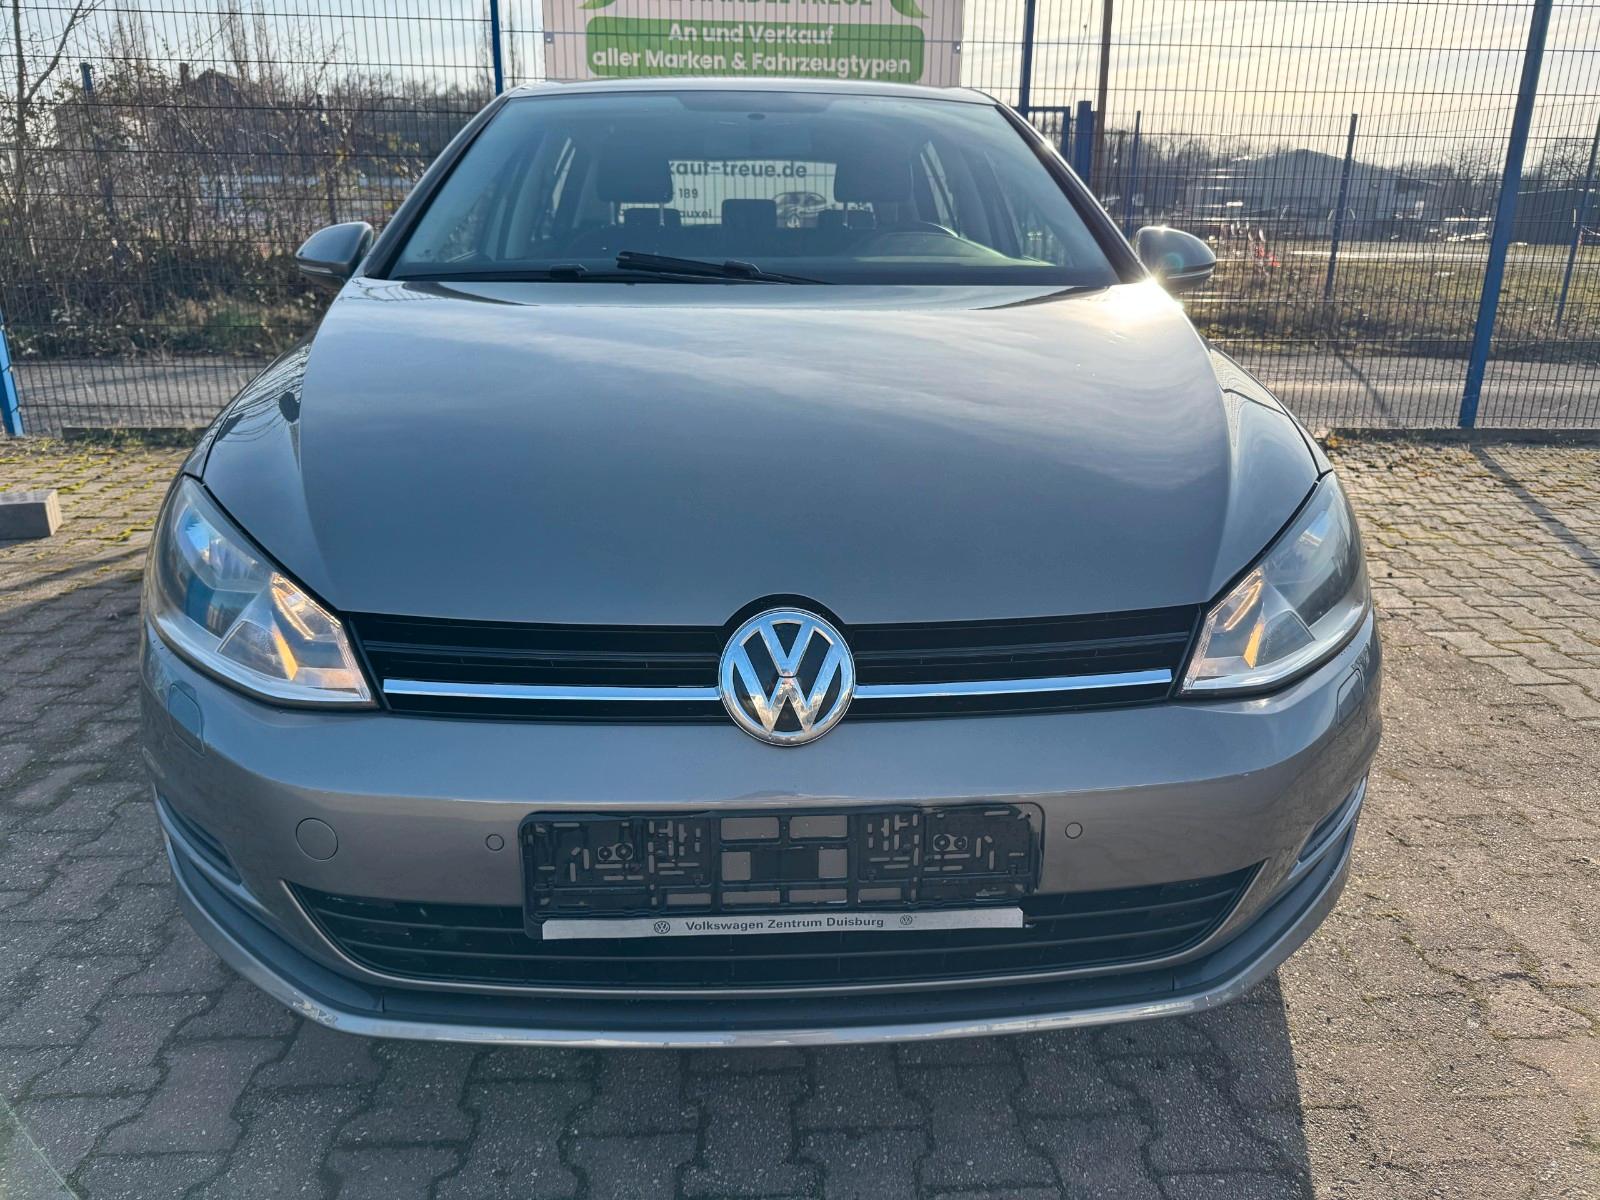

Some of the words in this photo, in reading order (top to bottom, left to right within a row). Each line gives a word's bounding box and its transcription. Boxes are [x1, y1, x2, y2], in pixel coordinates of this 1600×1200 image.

[668, 23, 698, 42] An
[702, 24, 744, 43] und
[748, 24, 834, 45] Verkauf
[592, 47, 641, 67] aller
[645, 49, 726, 70] Marken
[731, 52, 748, 70] &
[752, 52, 911, 78] Fahrzeugtypen
[678, 188, 699, 199] 189
[679, 208, 713, 218] auxel
[685, 920, 764, 931] Volkswagen
[767, 919, 822, 929] Zentrum
[826, 917, 884, 928] Duisburg
